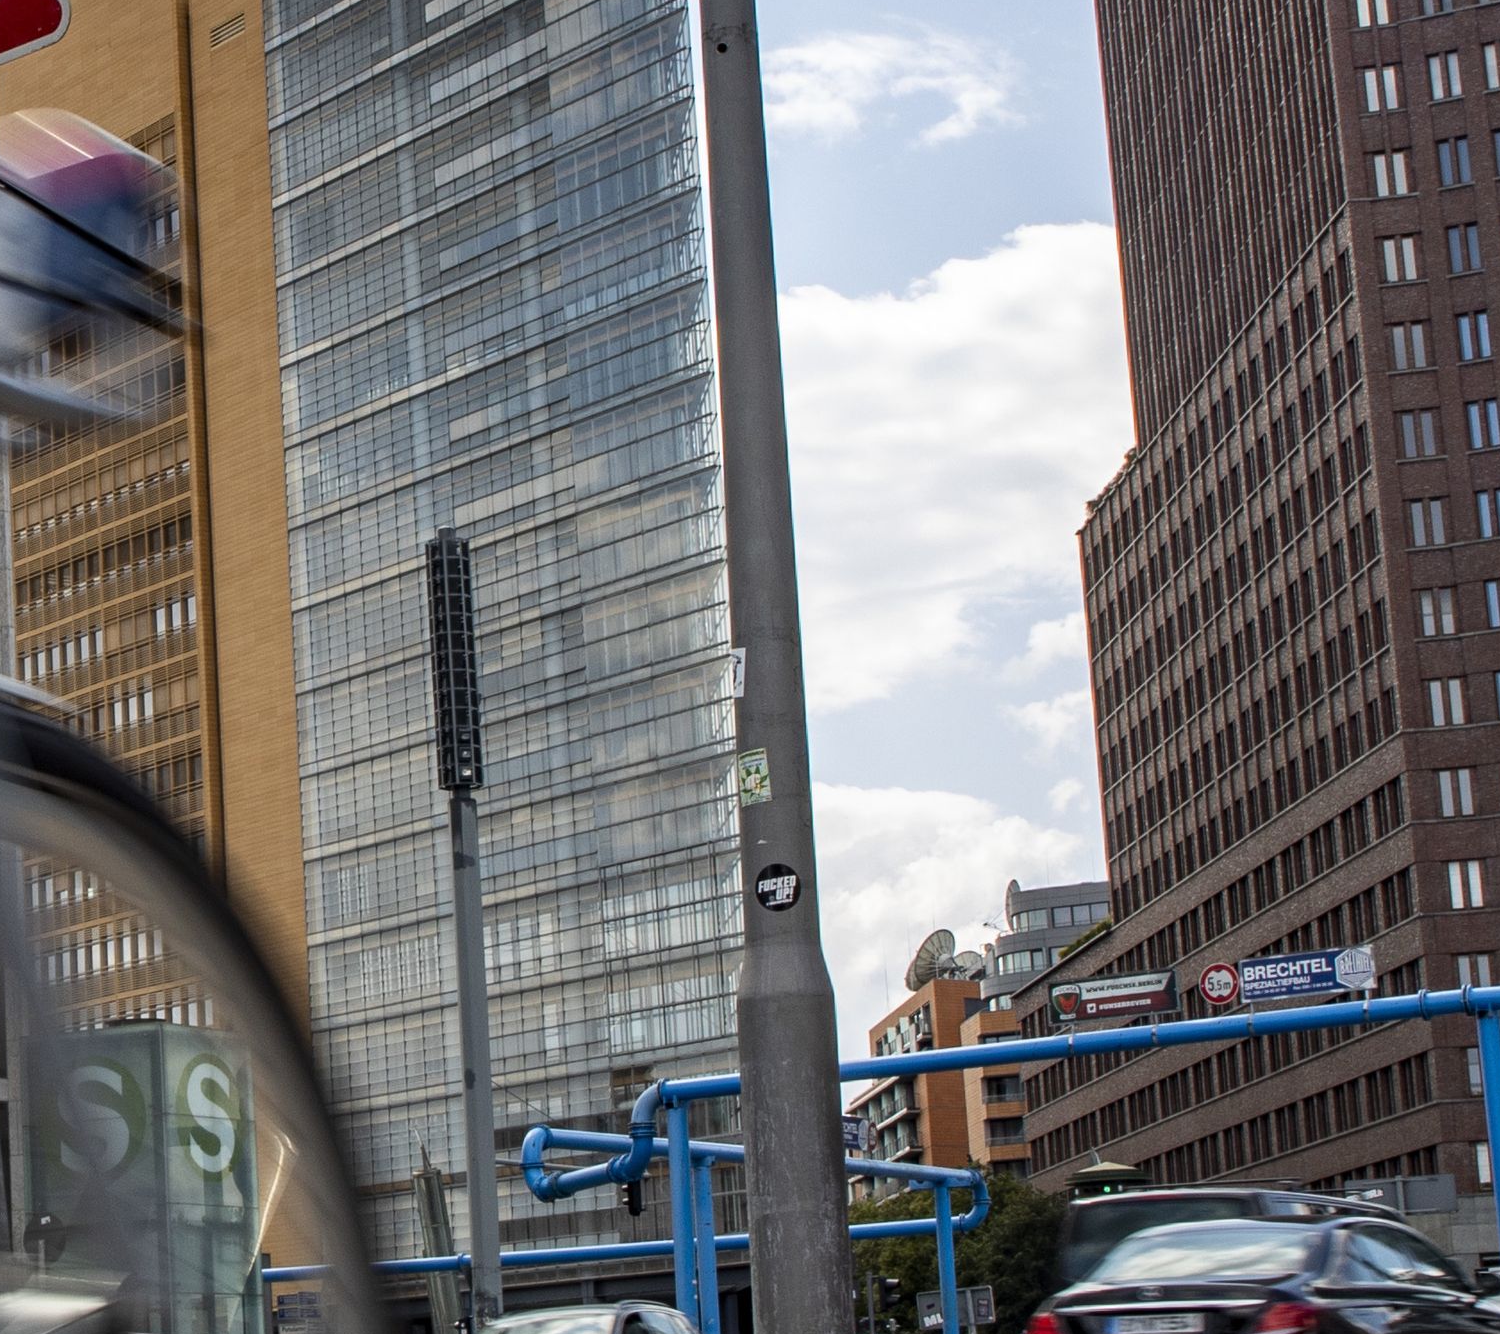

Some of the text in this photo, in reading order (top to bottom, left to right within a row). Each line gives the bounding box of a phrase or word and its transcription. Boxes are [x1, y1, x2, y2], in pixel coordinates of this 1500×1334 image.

[758, 875, 796, 893] FUCKED
[776, 887, 793, 900] UP!
[1243, 958, 1332, 981] BRECHTEL
[1244, 976, 1310, 991] SPEZIALTIEFBAU
[58, 1066, 130, 1172] S
[187, 1063, 235, 1172] S
